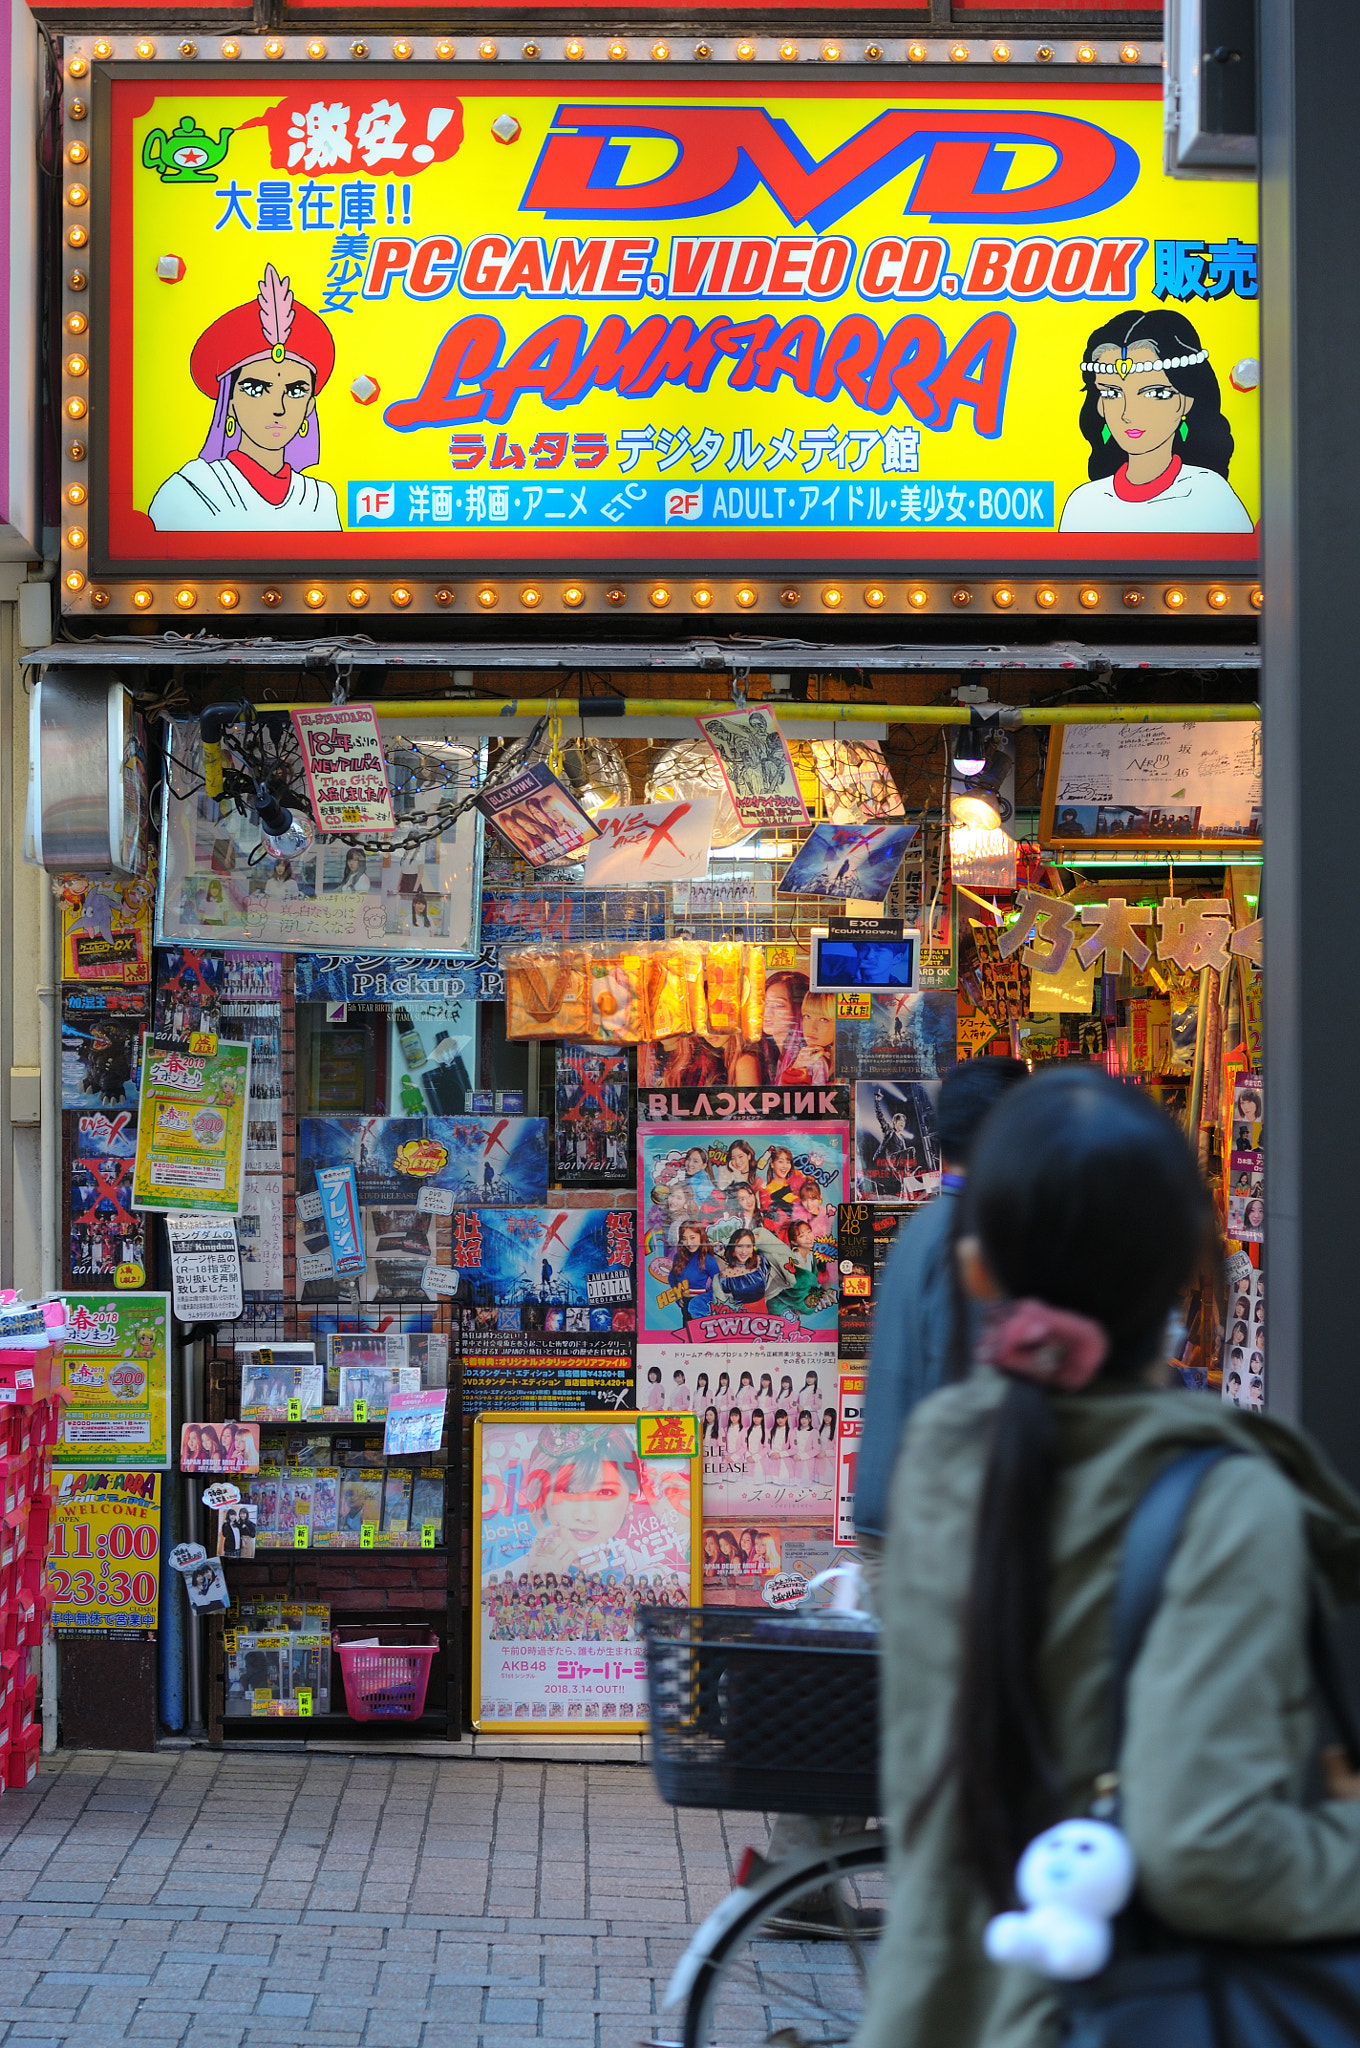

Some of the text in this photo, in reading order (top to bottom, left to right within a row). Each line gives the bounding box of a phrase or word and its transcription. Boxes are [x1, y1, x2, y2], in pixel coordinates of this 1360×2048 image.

[287, 100, 456, 168] 激安!
[517, 104, 1140, 234] DVD
[214, 181, 412, 232] 大量在庫!!
[318, 233, 371, 314] 美少女
[361, 236, 459, 300] PC
[667, 236, 857, 301] VIDEO
[960, 236, 1148, 301] BOOK
[1153, 238, 1258, 301] 販売
[383, 311, 1017, 440] LAMMTARRA
[447, 427, 921, 474] ラムタラ デジタルメディア館
[361, 483, 1046, 524] 1F 洋画・邦画・アニメ ETC 2F ADULT・アイドル・美少女・BOOK
[849, 919, 879, 928] EXO
[936, 968, 950, 976] OK
[352, 973, 465, 997] Pickup
[839, 993, 860, 1004] 入荷
[839, 1005, 869, 1016] しました!
[162, 1051, 206, 1074] 春 2018
[648, 1092, 839, 1117] BLACKPINK
[323, 1181, 355, 1255] フレッシュ
[840, 1204, 869, 1221] NMB
[171, 1230, 233, 1240] キングダムの
[840, 1219, 861, 1235] 48
[195, 1243, 235, 1252] Kingdom
[453, 1211, 483, 1268] 壮絶
[847, 1236, 868, 1246] LIVE
[173, 1254, 236, 1264] イメージ作品の
[175, 1273, 239, 1284] 取り扱いを再開
[588, 1280, 630, 1297] DIGITAL
[589, 1294, 632, 1305] MEDIA KAN
[70, 1307, 119, 1331] 春 2018
[701, 1316, 784, 1338] TWICE
[462, 1370, 555, 1378] Dスタンダード・エディション
[703, 1462, 749, 1474] ELEASE
[63, 1504, 148, 1519] WELCOME
[628, 1509, 681, 1539] AKB48
[49, 1523, 160, 1561] 11:00
[49, 1569, 158, 1606] 23:30
[501, 1661, 547, 1672] AKB48
[544, 1685, 625, 1695] 2018.3.14 OUT!!
